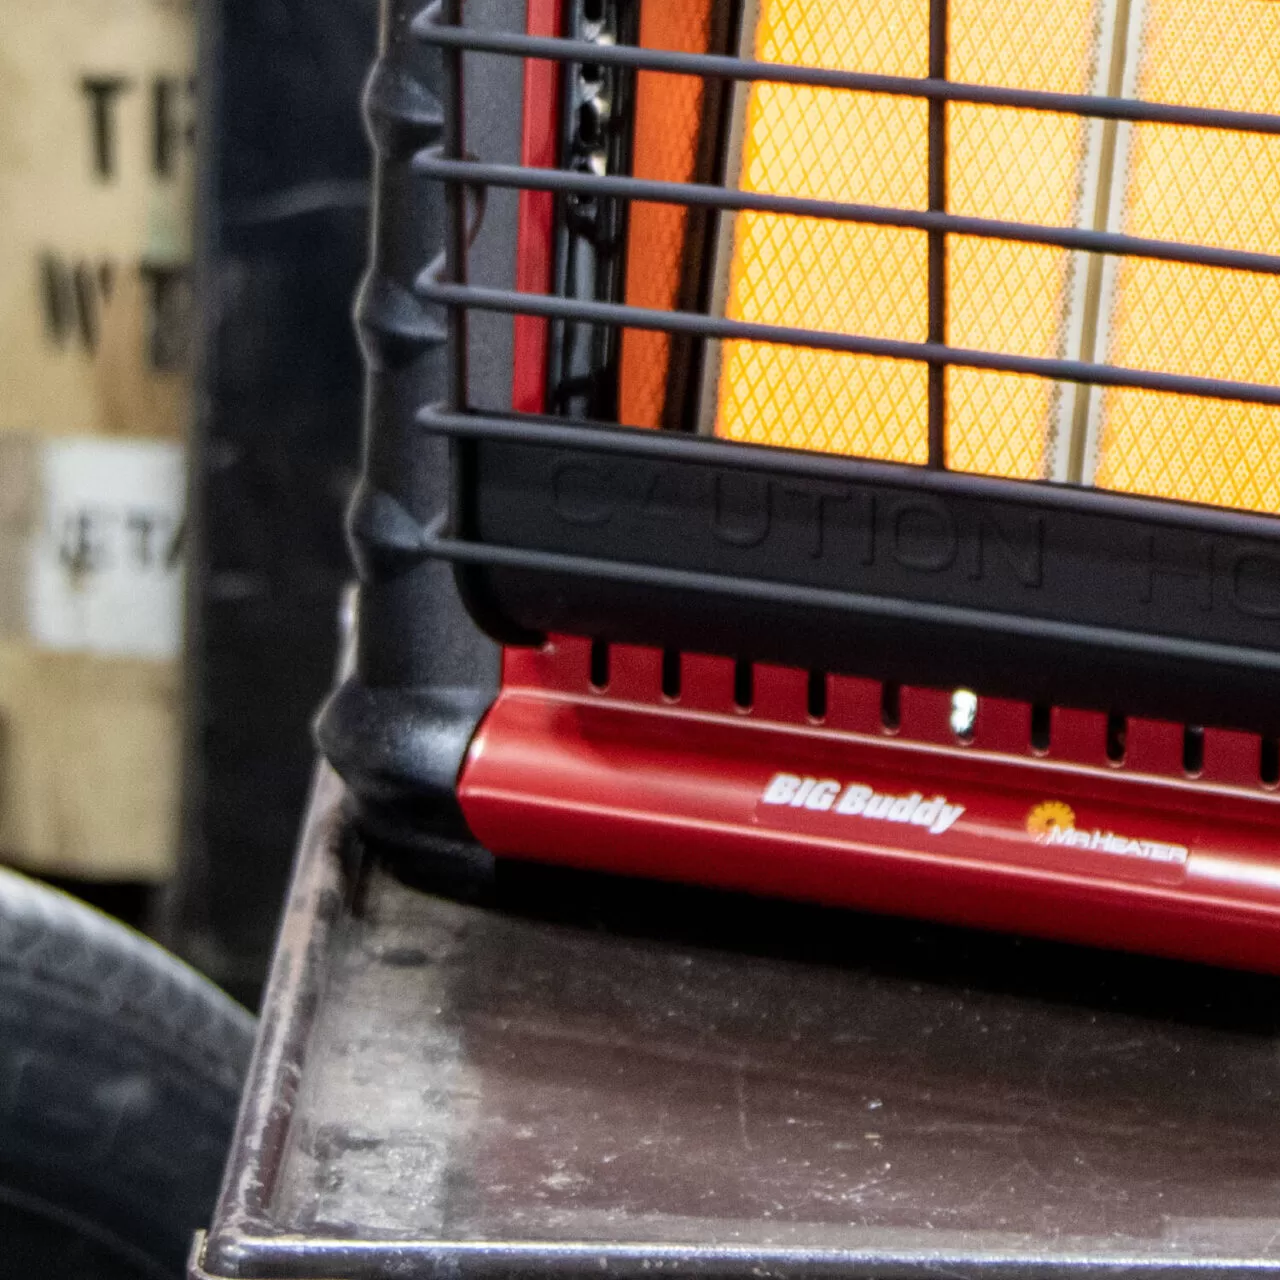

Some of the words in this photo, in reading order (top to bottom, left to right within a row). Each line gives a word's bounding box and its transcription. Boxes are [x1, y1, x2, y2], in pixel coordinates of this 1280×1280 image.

[550, 460, 1046, 588] CAUTION
[763, 773, 841, 811] BIG
[834, 784, 965, 834] Buddy
